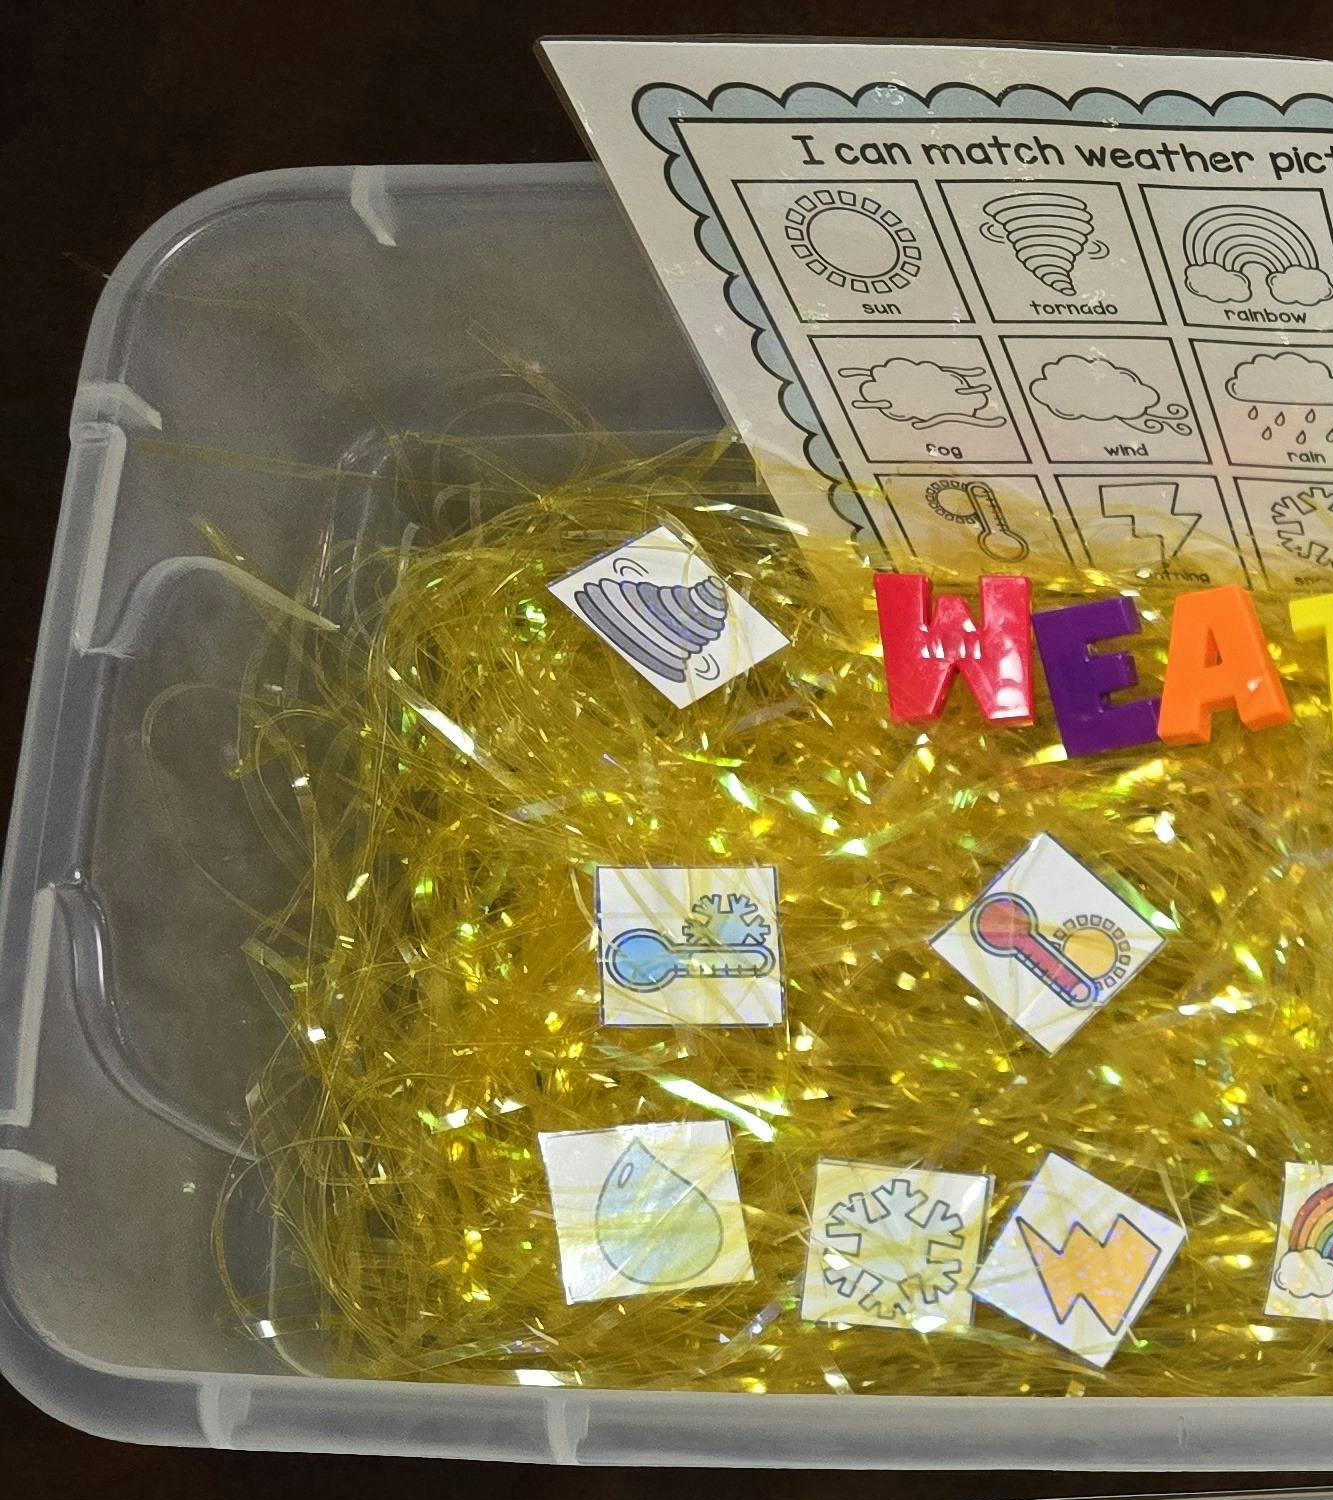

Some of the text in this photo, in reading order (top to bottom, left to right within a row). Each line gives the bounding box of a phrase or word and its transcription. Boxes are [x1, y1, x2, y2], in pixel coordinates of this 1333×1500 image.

[792, 135, 825, 166] I
[834, 140, 913, 166] can
[921, 135, 1065, 167] match
[1074, 142, 1254, 174] weather
[862, 301, 902, 316] sun
[1029, 300, 1119, 316] tornado
[1223, 306, 1308, 325] rainbow
[1104, 443, 1150, 457] wind
[1287, 450, 1327, 465] rain
